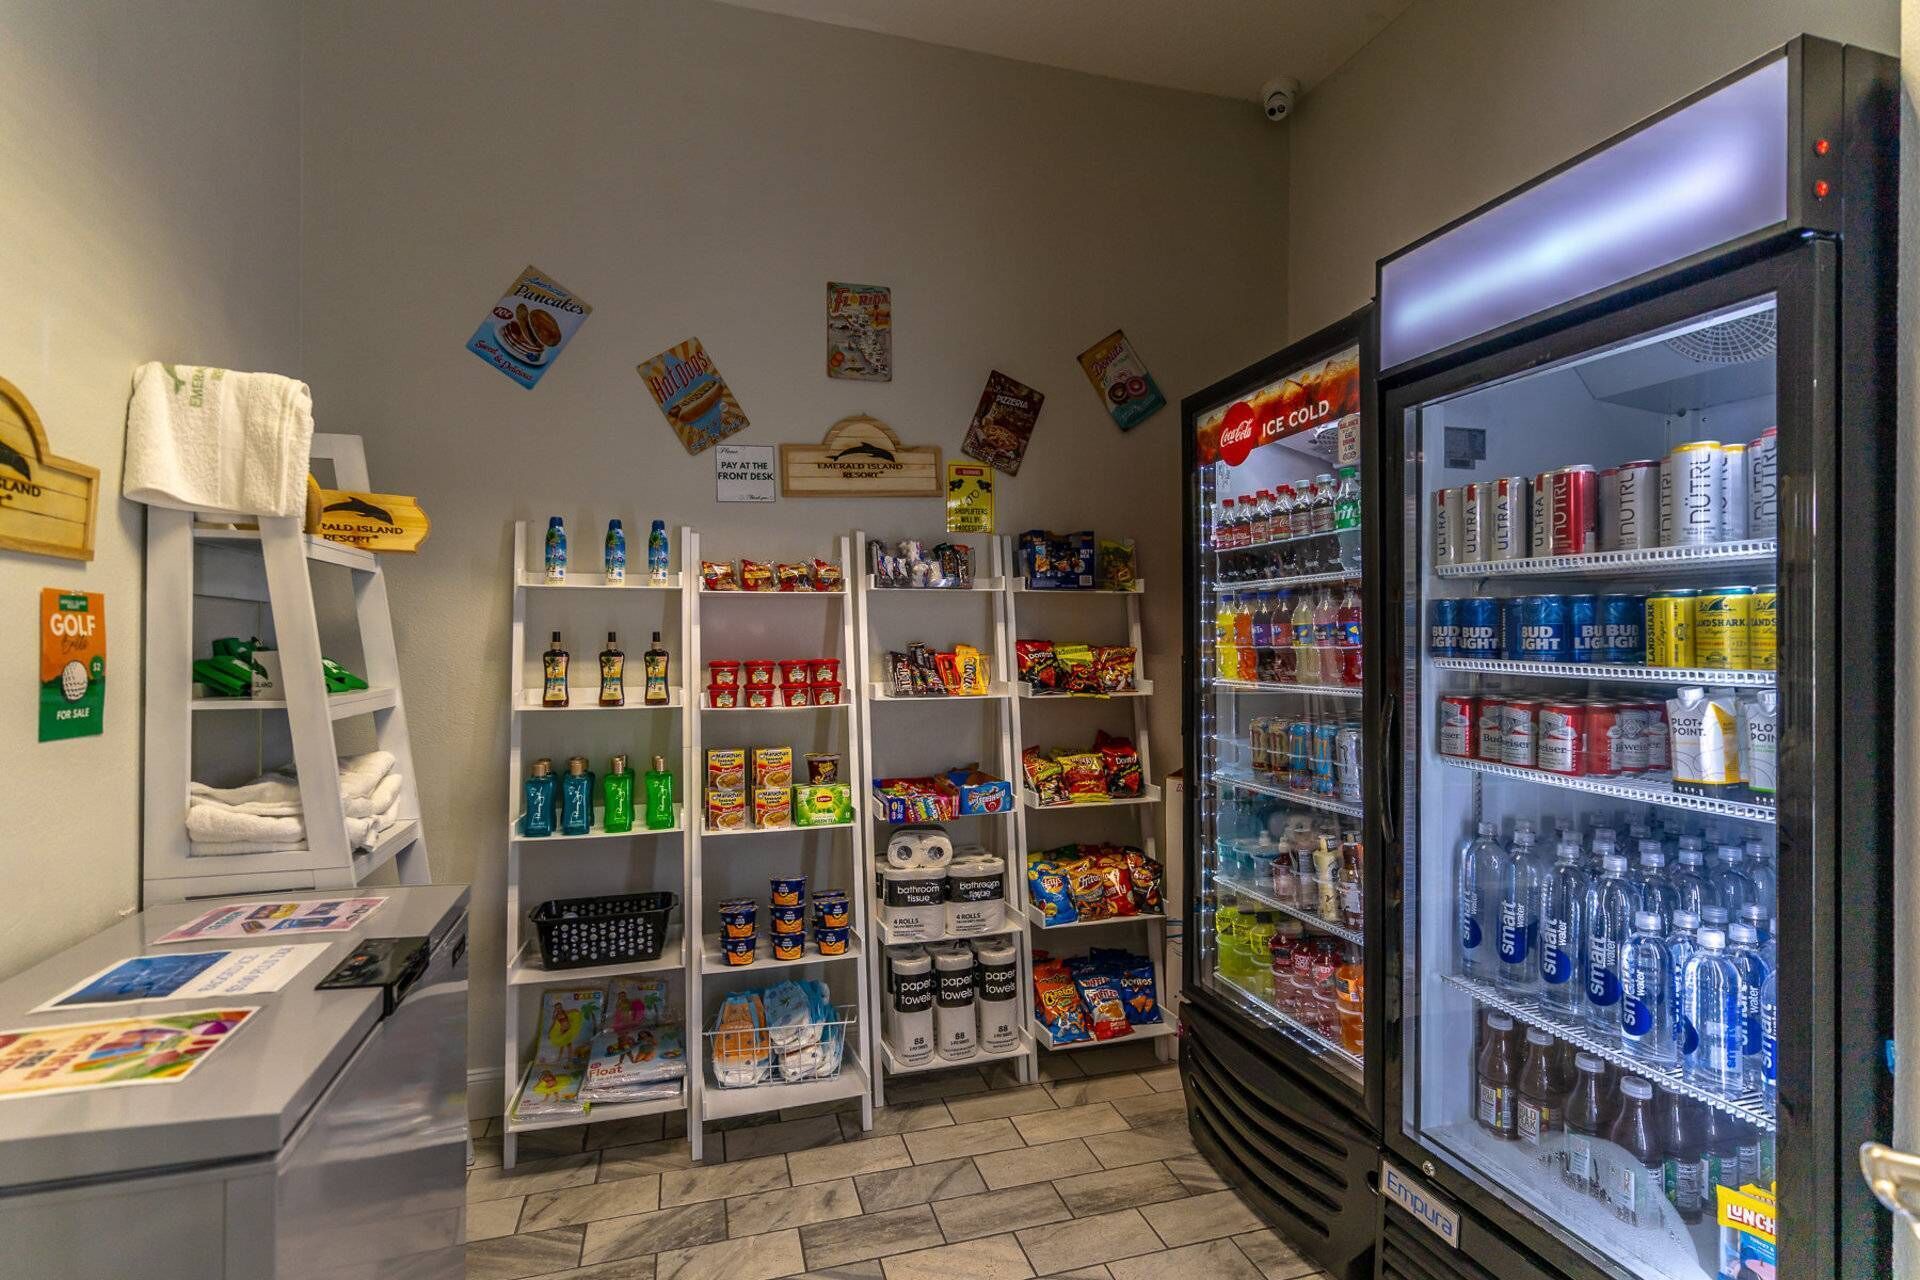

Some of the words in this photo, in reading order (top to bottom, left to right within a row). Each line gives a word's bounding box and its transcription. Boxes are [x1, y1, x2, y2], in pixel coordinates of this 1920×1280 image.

[513, 284, 584, 315] Pancakes
[649, 366, 680, 404] Hot
[1262, 416, 1285, 438] ICE
[1288, 400, 1330, 428] COLD
[721, 461, 738, 469] PAY
[739, 462, 751, 470] AT
[752, 462, 768, 470] THE
[717, 472, 748, 480] FRONT
[356, 525, 404, 535] ISLAND
[1465, 505, 1477, 553] ULTRA
[1497, 500, 1509, 551] ULTRA
[1534, 495, 1544, 548] ULTRA
[50, 612, 96, 637] GOLF
[1461, 626, 1493, 638] BUD
[1521, 626, 1554, 638] BUD
[1028, 651, 1054, 660] Doritos
[56, 710, 72, 720] FOR
[72, 707, 91, 719] SALE
[897, 885, 940, 894] bathroom
[959, 880, 1000, 890] bathroom
[907, 894, 931, 902] tissue
[1516, 902, 1525, 928] water
[1501, 900, 1517, 955] smart
[1557, 919, 1567, 946] water
[1543, 918, 1558, 976] smart
[1606, 940, 1617, 966] water
[1590, 935, 1606, 996] smart
[941, 974, 972, 987] paper
[985, 969, 1016, 982] paper
[1121, 978, 1153, 988] Doritos
[1636, 969, 1646, 997] water
[901, 978, 931, 992] paper
[941, 988, 973, 1000] towels
[985, 982, 1016, 994] towels
[901, 992, 931, 1005] towels
[1043, 985, 1075, 1007] Cheetos
[1748, 985, 1759, 1013] water
[1387, 1170, 1453, 1237] Empura
